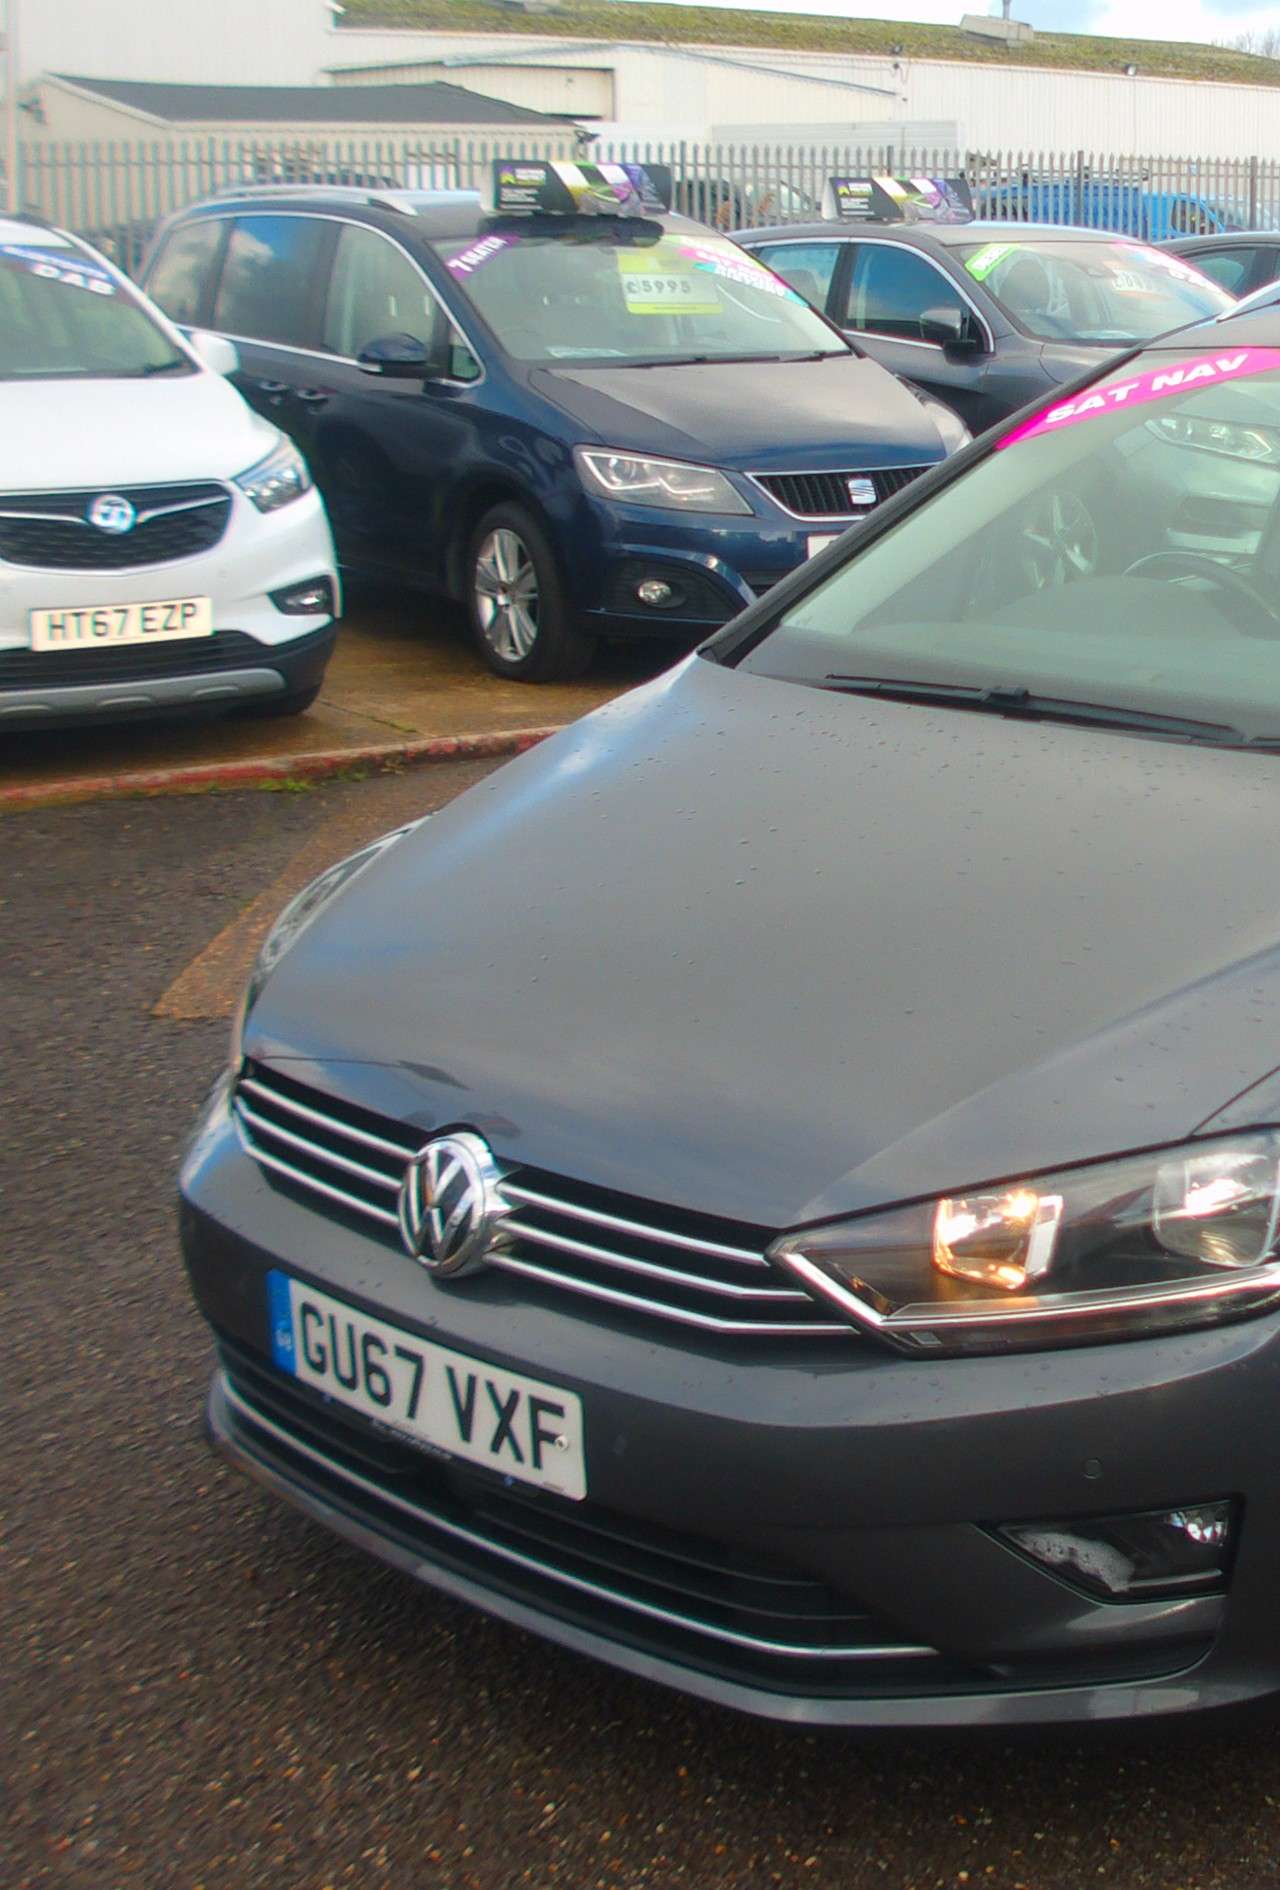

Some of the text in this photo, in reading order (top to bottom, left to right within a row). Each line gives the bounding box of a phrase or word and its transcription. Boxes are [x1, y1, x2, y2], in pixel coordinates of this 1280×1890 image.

[1045, 353, 1249, 424] SAT NAV
[48, 602, 197, 641] HT67 EZP
[301, 1301, 425, 1420] GU67
[445, 1363, 566, 1470] VXF
